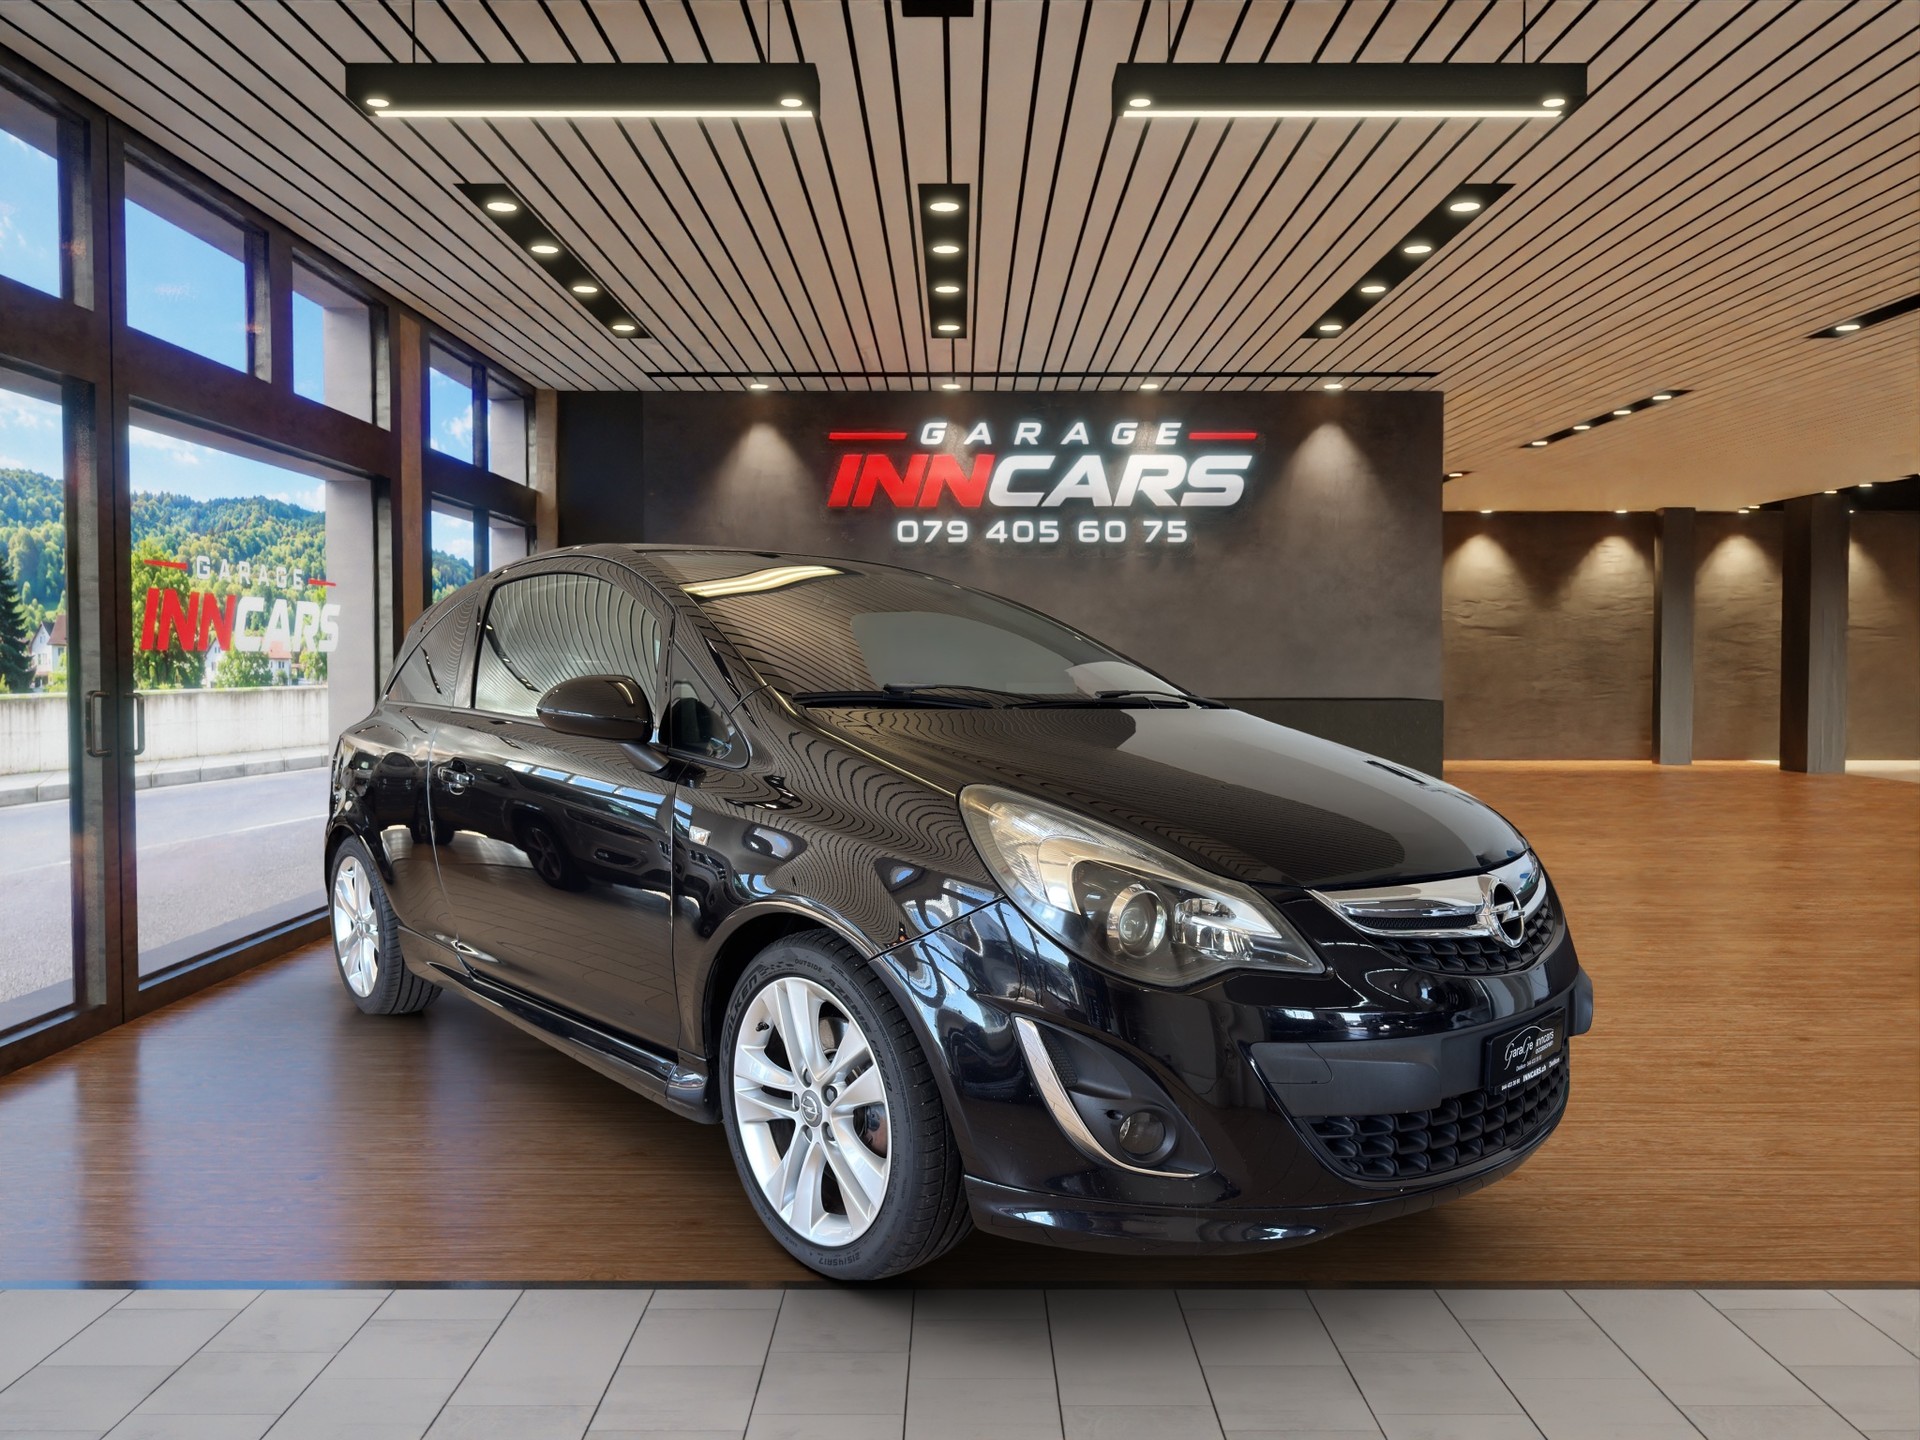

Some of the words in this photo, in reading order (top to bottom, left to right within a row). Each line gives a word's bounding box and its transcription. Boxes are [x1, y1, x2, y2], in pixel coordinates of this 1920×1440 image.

[920, 422, 1182, 445] GARAGE
[827, 454, 1253, 508] INNCARS
[896, 520, 968, 544] 079
[985, 520, 1060, 544] 405
[1077, 520, 1126, 544] 60
[1143, 520, 1188, 544] 75
[196, 555, 303, 590] GARAGE
[140, 587, 341, 652] INNCARS
[794, 958, 823, 972] OUTSIDE
[824, 978, 872, 1033] AZENIS
